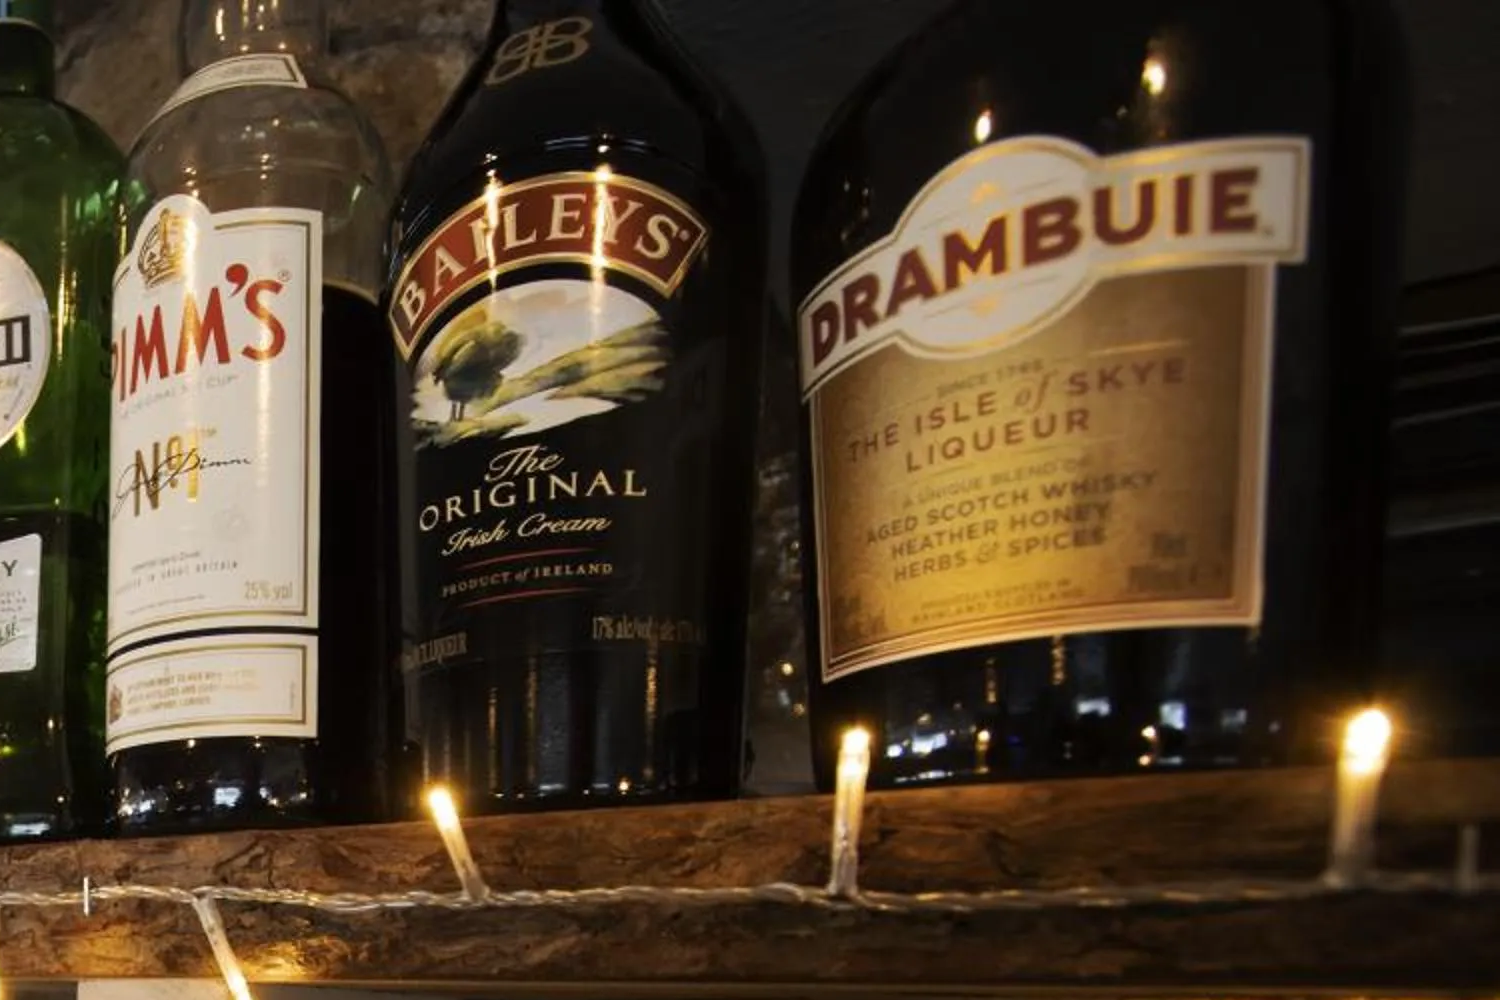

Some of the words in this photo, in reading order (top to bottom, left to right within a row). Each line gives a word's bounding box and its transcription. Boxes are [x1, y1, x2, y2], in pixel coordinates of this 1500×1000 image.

[399, 191, 685, 328] BAILEYS
[809, 166, 1260, 369] DRAMBUIE
[846, 423, 901, 464] THE
[914, 391, 999, 436] ISLE
[1066, 357, 1187, 397] SKYE
[906, 408, 1092, 474] LIQUEUR
[484, 444, 565, 483] The
[418, 469, 648, 532] ORIGINAL
[865, 513, 919, 546] AGED
[926, 490, 1030, 527] SCOTCH
[1040, 469, 1160, 502] WHISKY
[890, 517, 999, 561] HEATHER
[1007, 501, 1113, 536] HONEY
[441, 518, 510, 557] Irish
[517, 512, 614, 538] Cream
[442, 571, 509, 598] PRODUCT
[534, 562, 615, 580] IRELAND
[893, 550, 969, 584] HERBS
